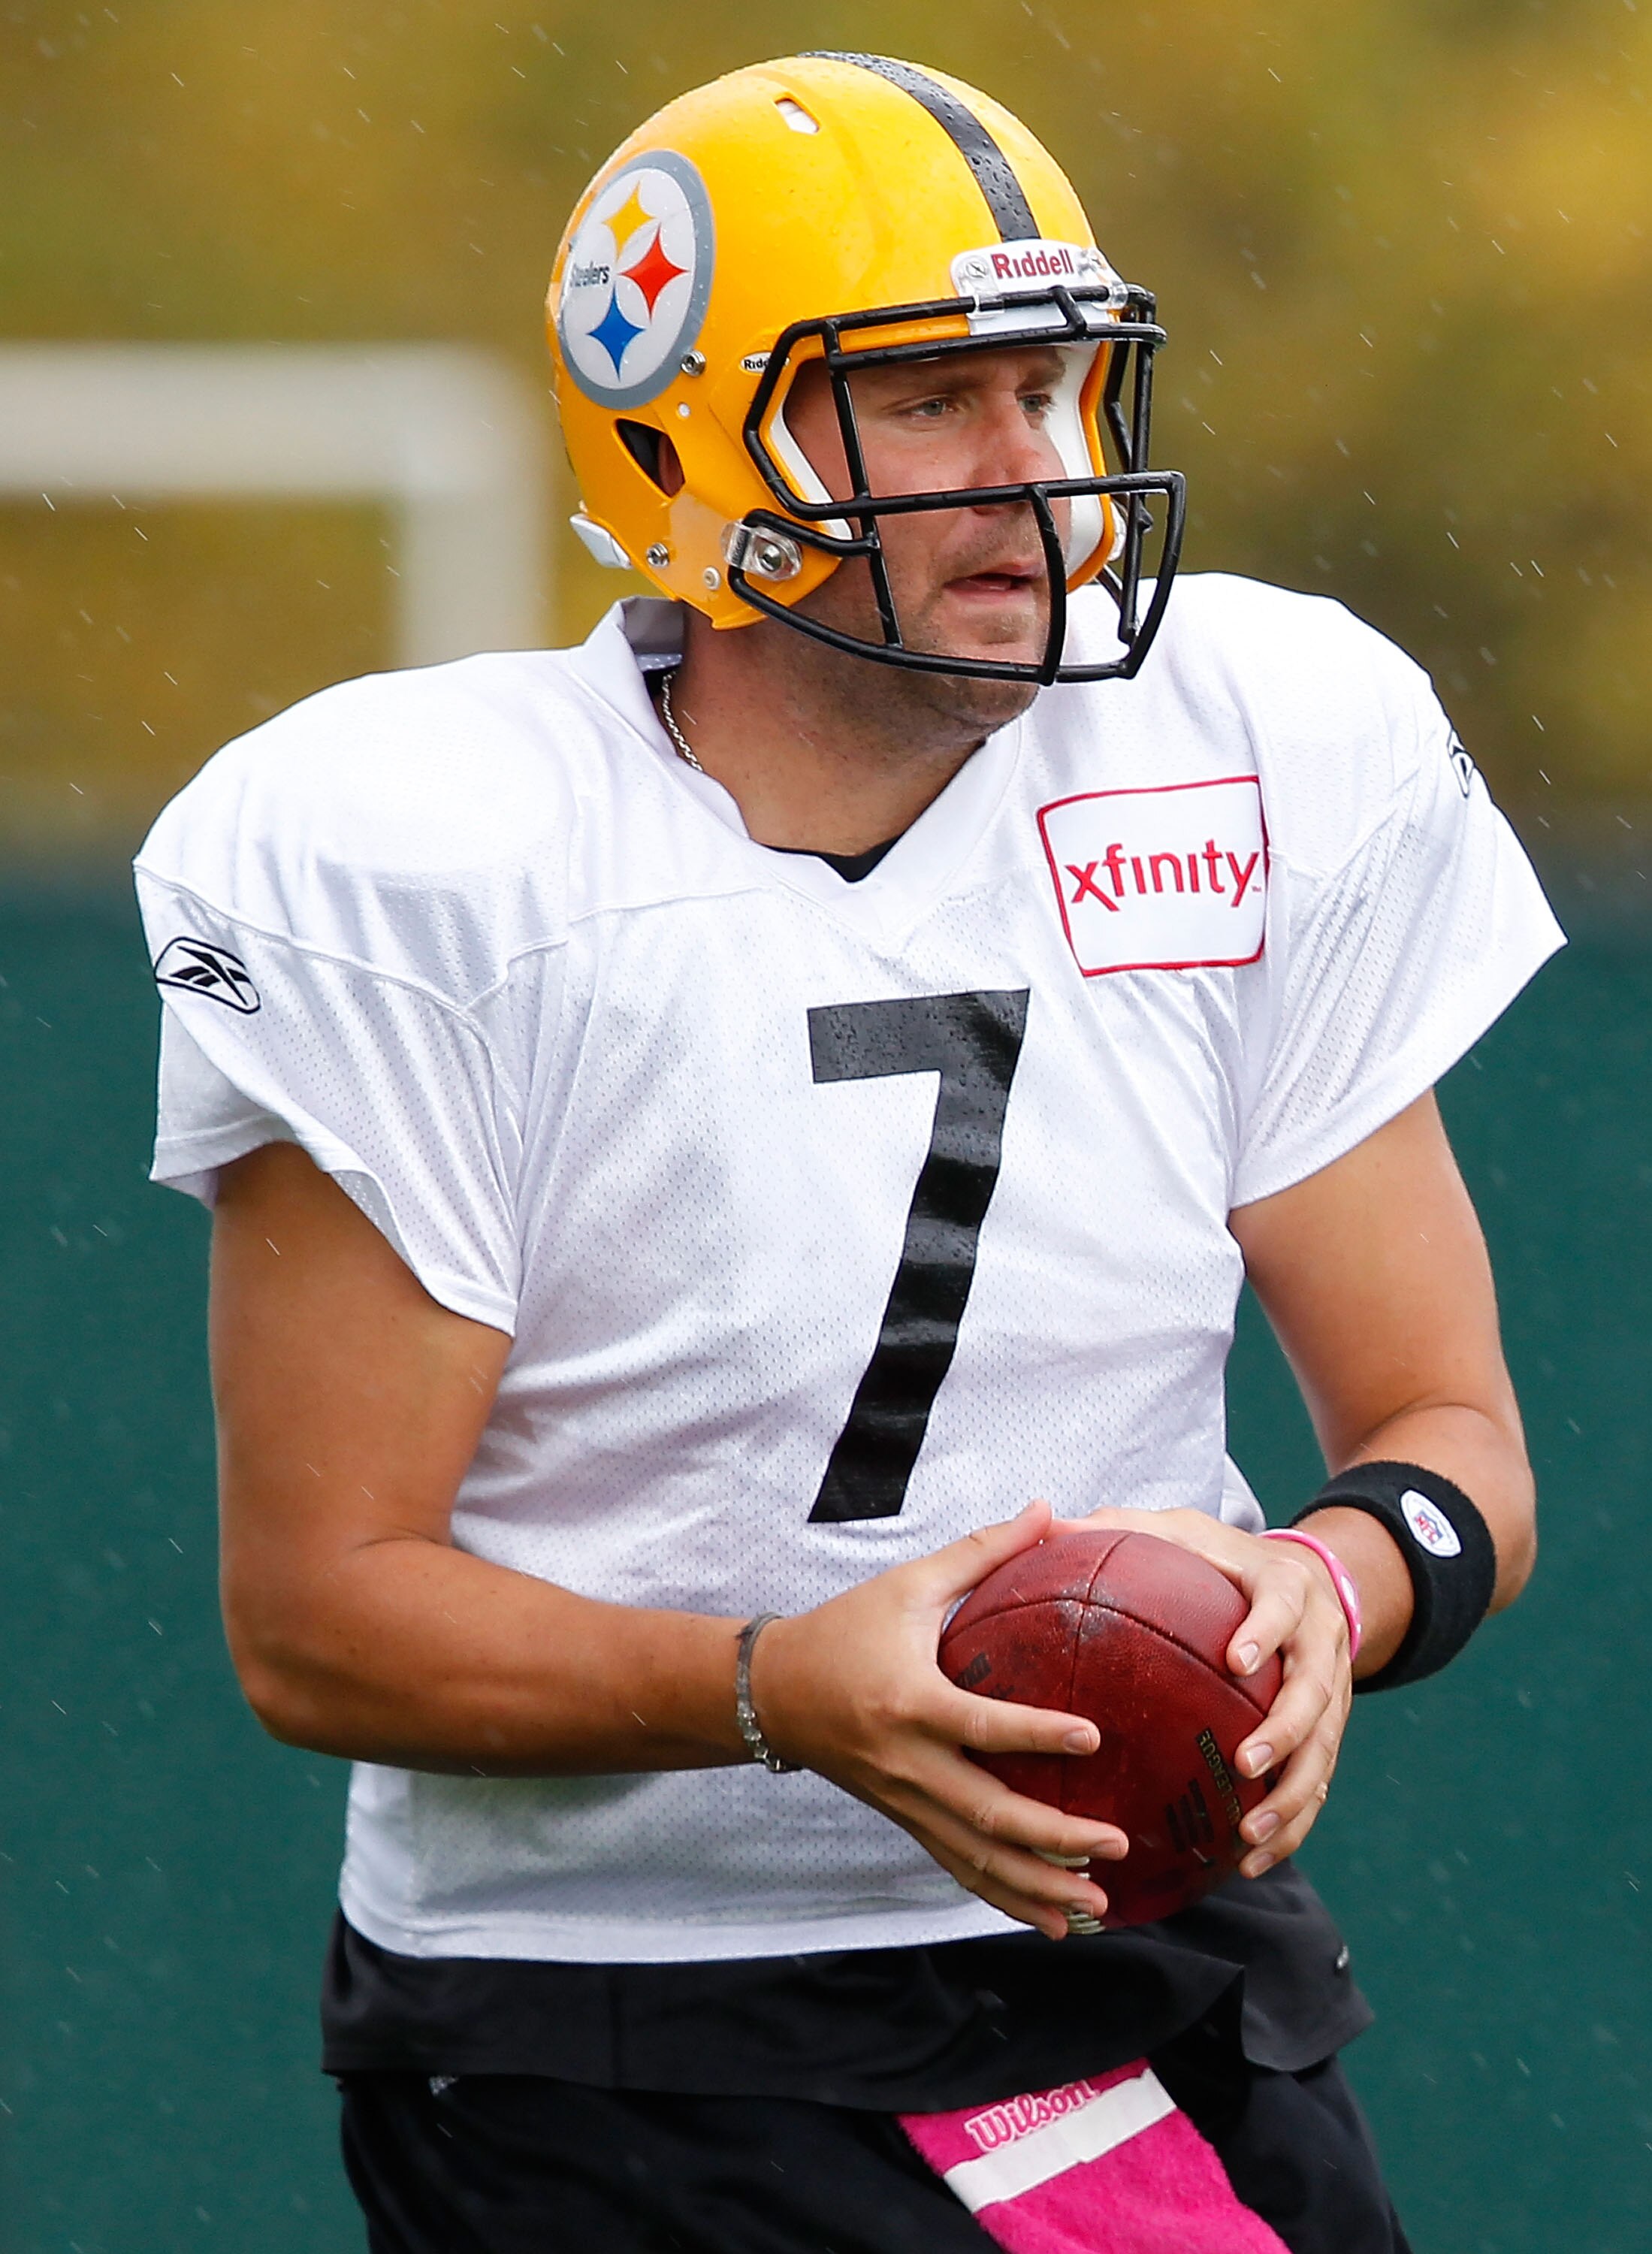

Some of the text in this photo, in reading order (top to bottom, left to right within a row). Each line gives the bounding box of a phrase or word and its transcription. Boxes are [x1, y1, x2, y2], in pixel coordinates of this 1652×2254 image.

[991, 249, 1074, 279] Riddell
[1065, 839, 1260, 912] xfinity
[807, 988, 1031, 1523] 7
[965, 2080, 1096, 2152] Wilson
